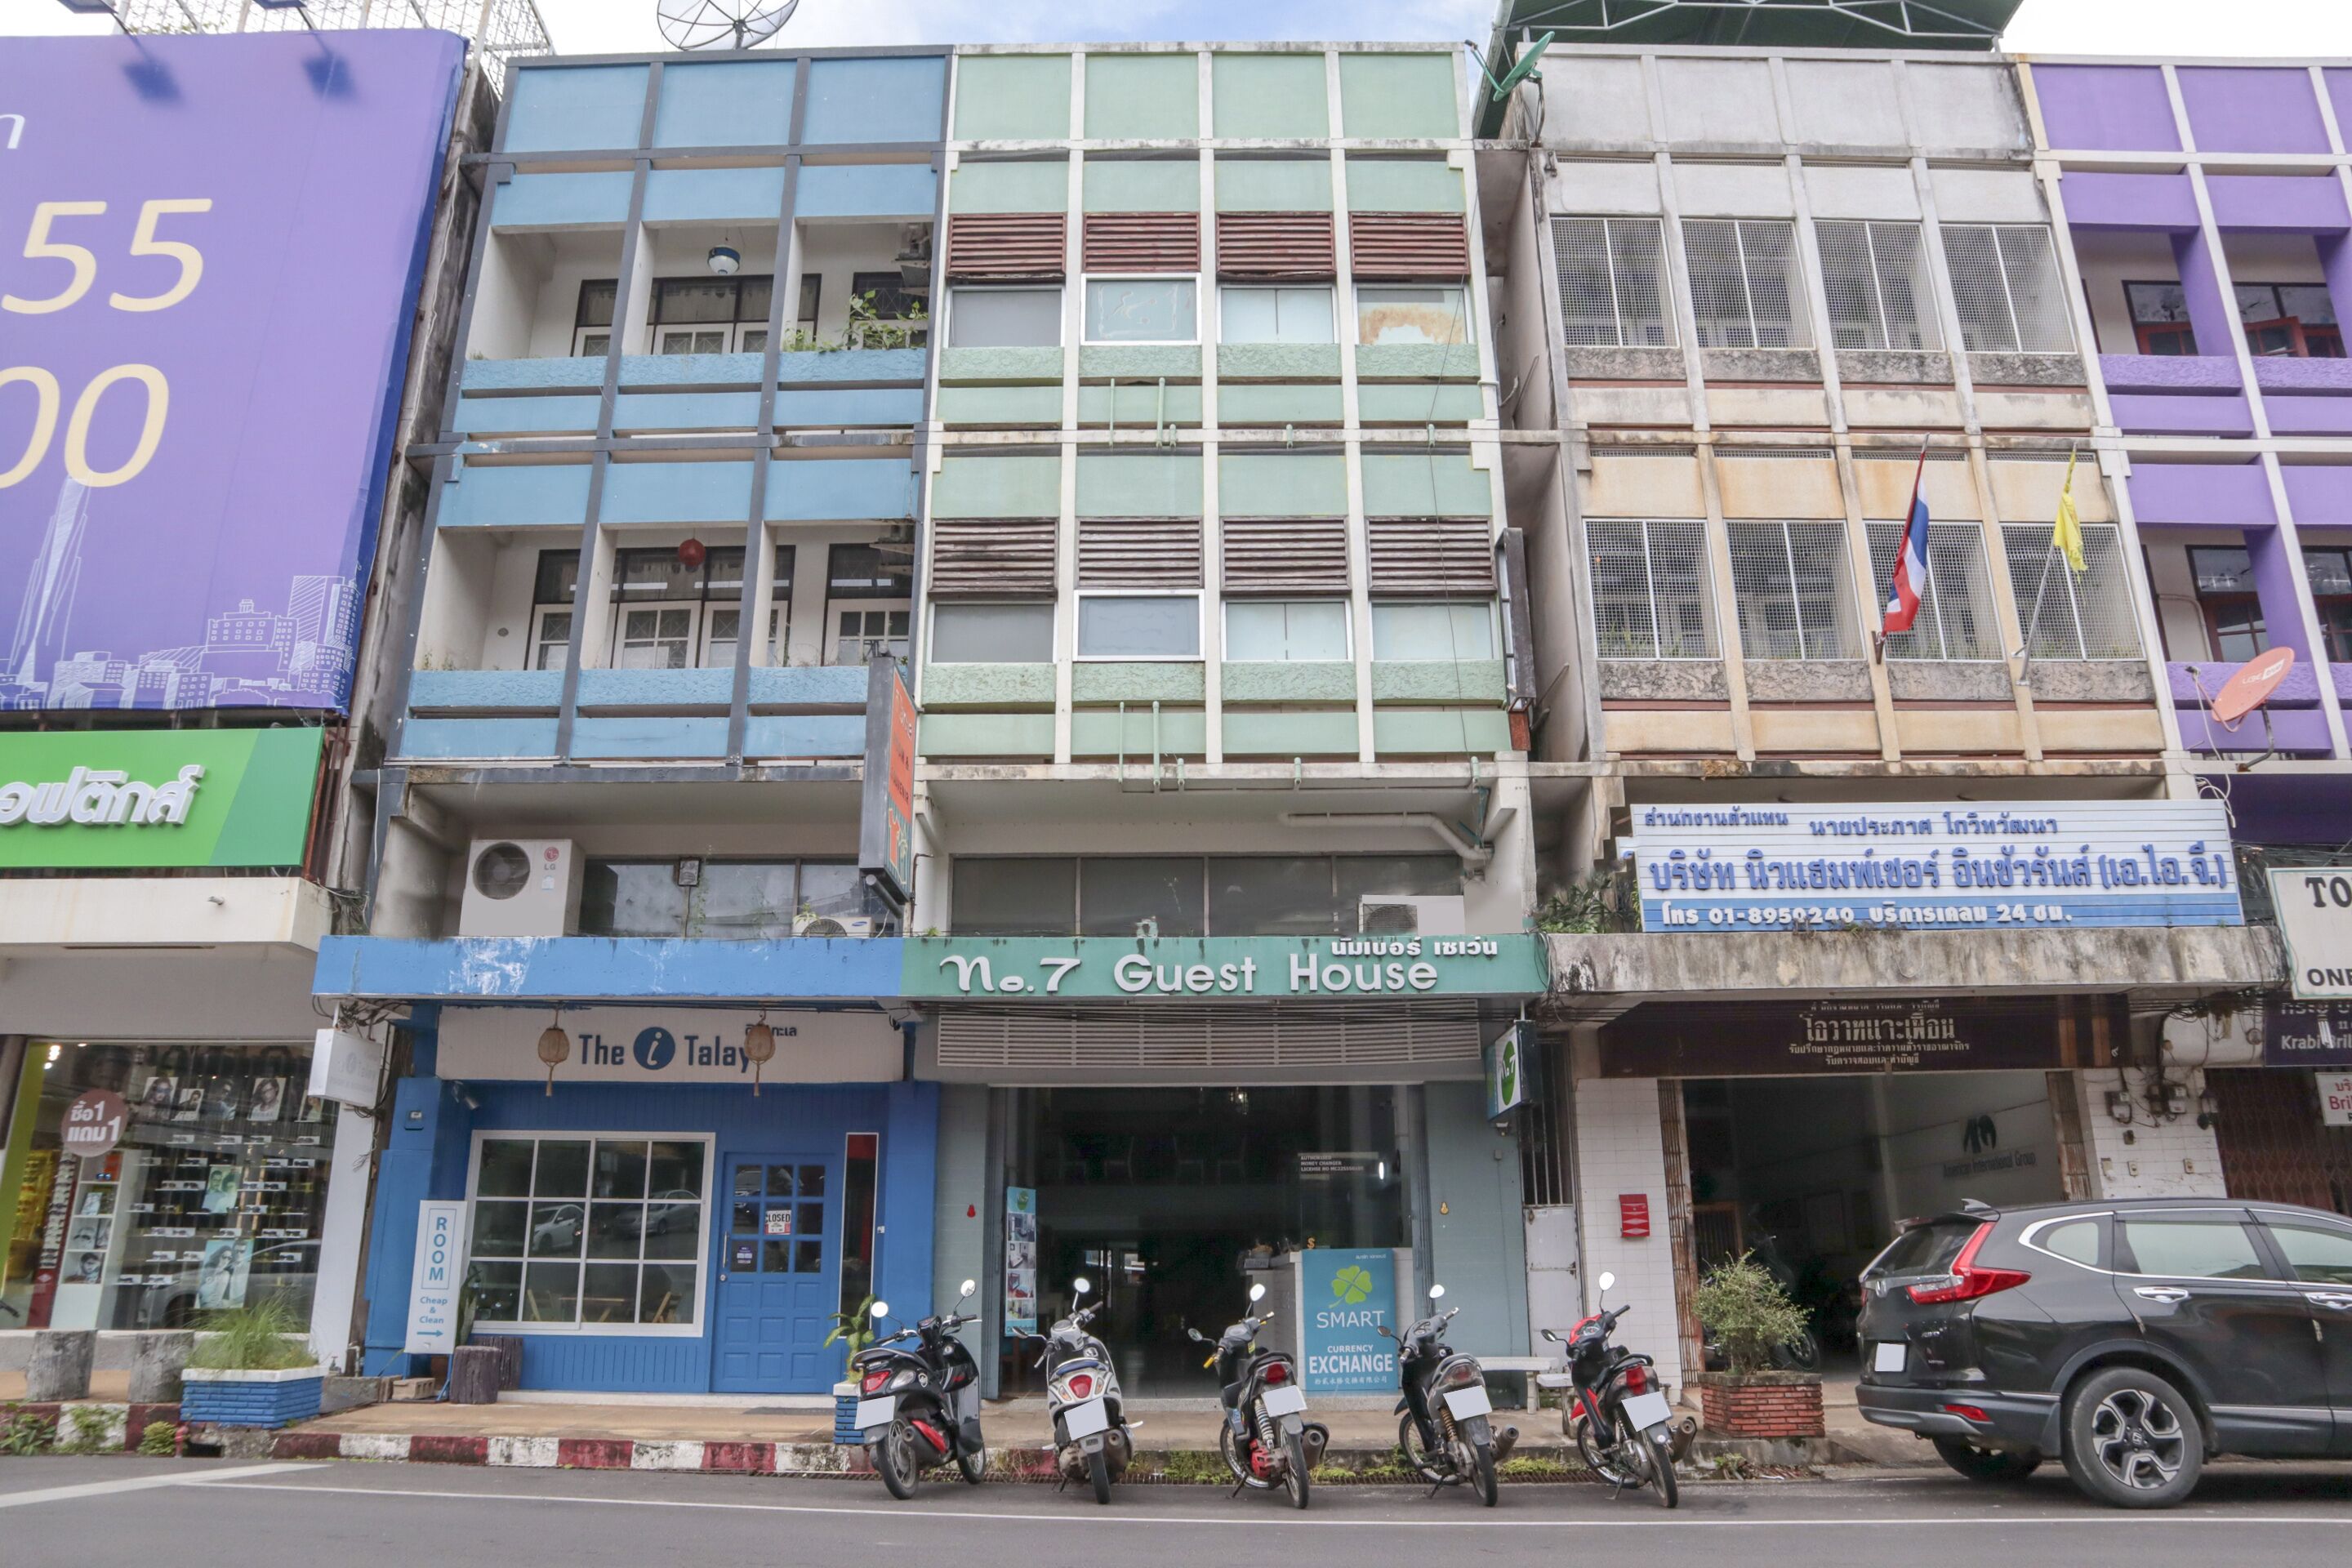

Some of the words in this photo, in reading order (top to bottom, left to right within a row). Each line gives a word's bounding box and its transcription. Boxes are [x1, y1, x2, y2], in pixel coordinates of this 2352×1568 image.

[1650, 848, 1735, 890] บริษัท
[1662, 902, 1699, 925] โทร
[1709, 906, 1855, 925] 01-8950240
[1869, 901, 1988, 924] บริการเคลม
[1996, 903, 2027, 922] 24
[2034, 904, 2073, 922] ชม.
[1114, 954, 1256, 992] Guest
[1290, 953, 1437, 991] House
[2281, 1035, 2321, 1049] Krabi
[578, 1035, 624, 1065] The
[684, 1036, 749, 1073] Talay
[70, 1100, 94, 1121] ซื้อ
[94, 1100, 105, 1121] 1
[67, 1126, 107, 1142] แถม
[107, 1116, 121, 1142] 1
[429, 1217, 448, 1281] ROOM
[420, 1296, 448, 1305] Cheap
[419, 1316, 443, 1324] Clean
[1316, 1311, 1385, 1329] SMART
[1327, 1344, 1374, 1353] CURRENCY
[1309, 1354, 1393, 1374] EXCHANGE
